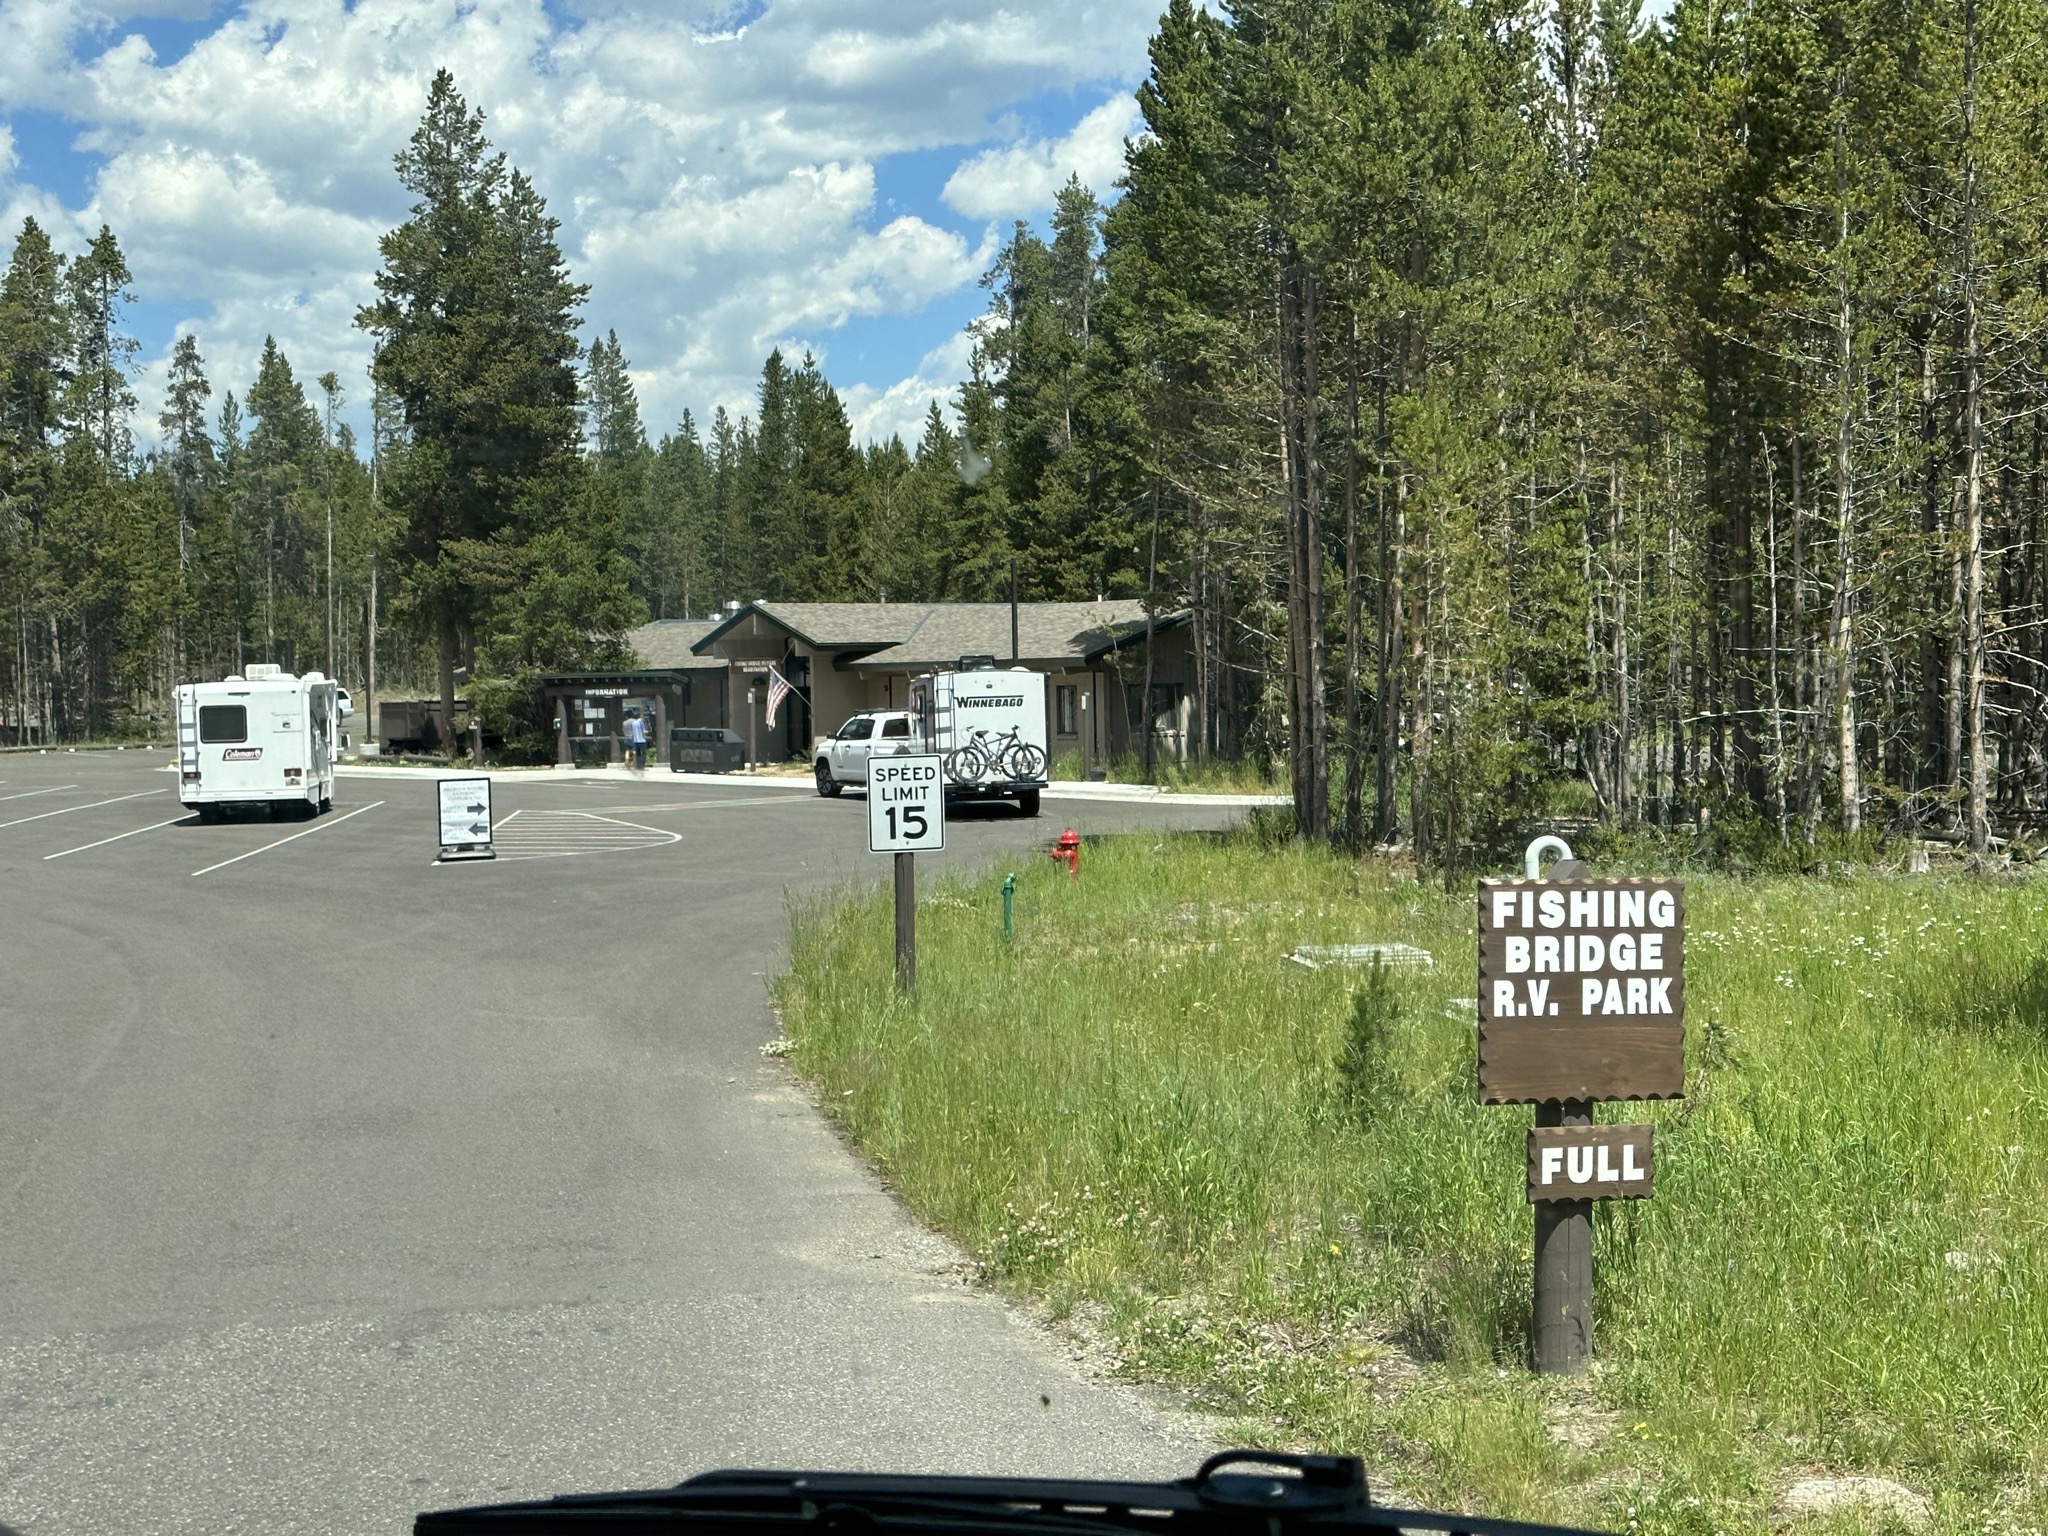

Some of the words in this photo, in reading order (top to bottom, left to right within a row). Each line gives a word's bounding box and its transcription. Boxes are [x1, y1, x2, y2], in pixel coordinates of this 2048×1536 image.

[585, 688, 629, 696] INFORMATION
[955, 695, 1024, 708] WINNEBAGO
[225, 749, 255, 759] Coleman
[875, 767, 936, 782] SPEED
[882, 786, 930, 802] LIMIT
[885, 806, 928, 840] 15
[1492, 890, 1676, 928] FISHING
[1505, 933, 1664, 973] BRIDGE
[1493, 979, 1559, 1017] R.V.
[1582, 977, 1673, 1016] PARK
[1541, 1144, 1645, 1185] FULL
